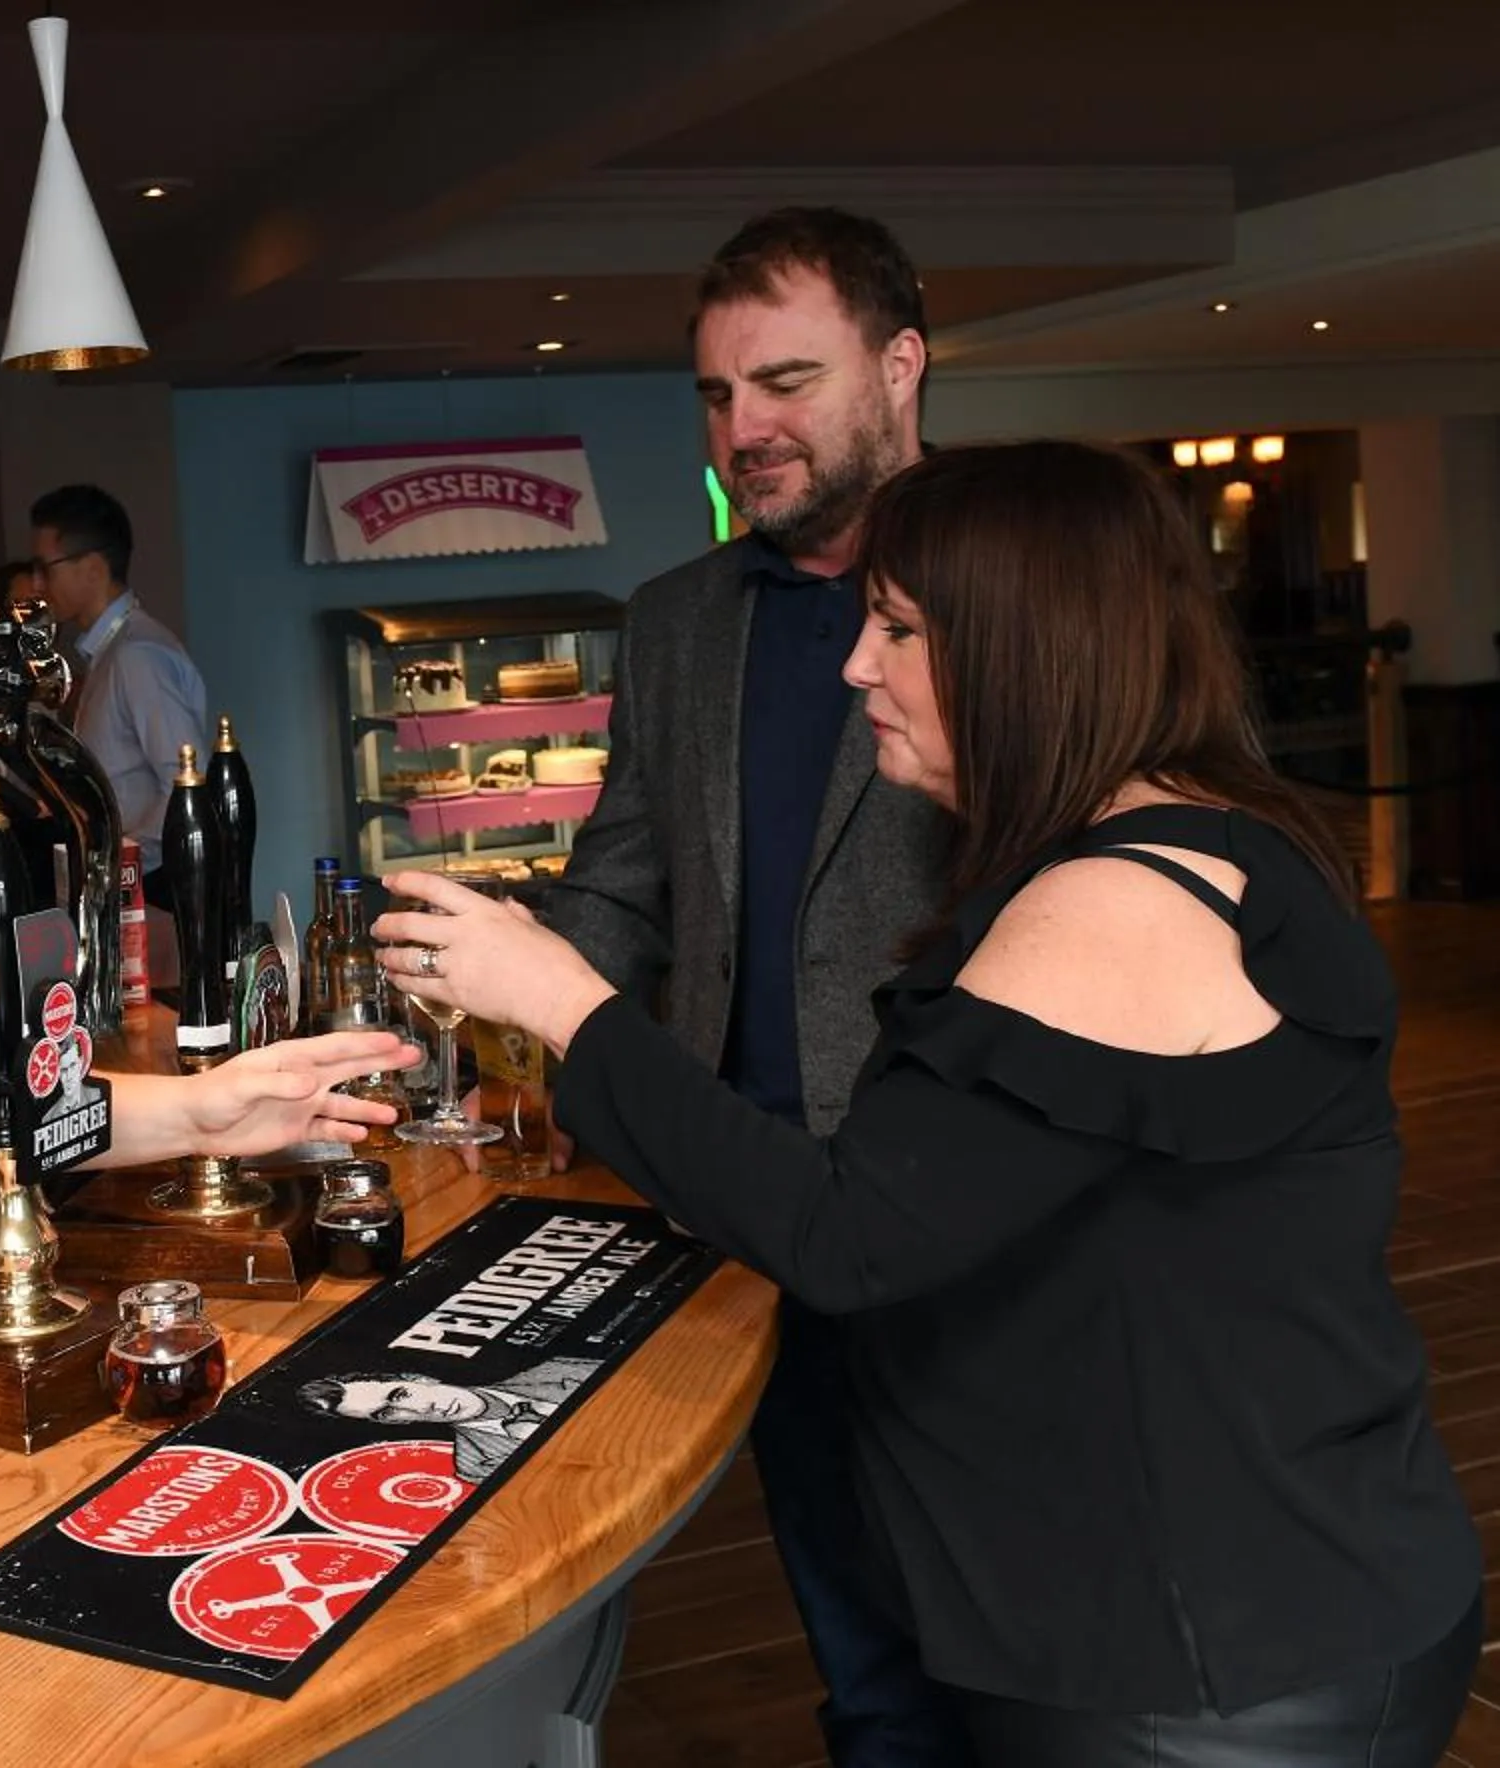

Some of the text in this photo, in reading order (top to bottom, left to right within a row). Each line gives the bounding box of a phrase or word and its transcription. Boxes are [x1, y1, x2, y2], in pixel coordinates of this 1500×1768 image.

[380, 472, 538, 516] DESSERTS
[32, 1100, 108, 1158] PEDIGREE
[388, 1214, 630, 1359] PEDIGREE
[541, 1266, 628, 1320] AMBER
[602, 1237, 660, 1267] ALE
[185, 1487, 261, 1540] BREWERY
